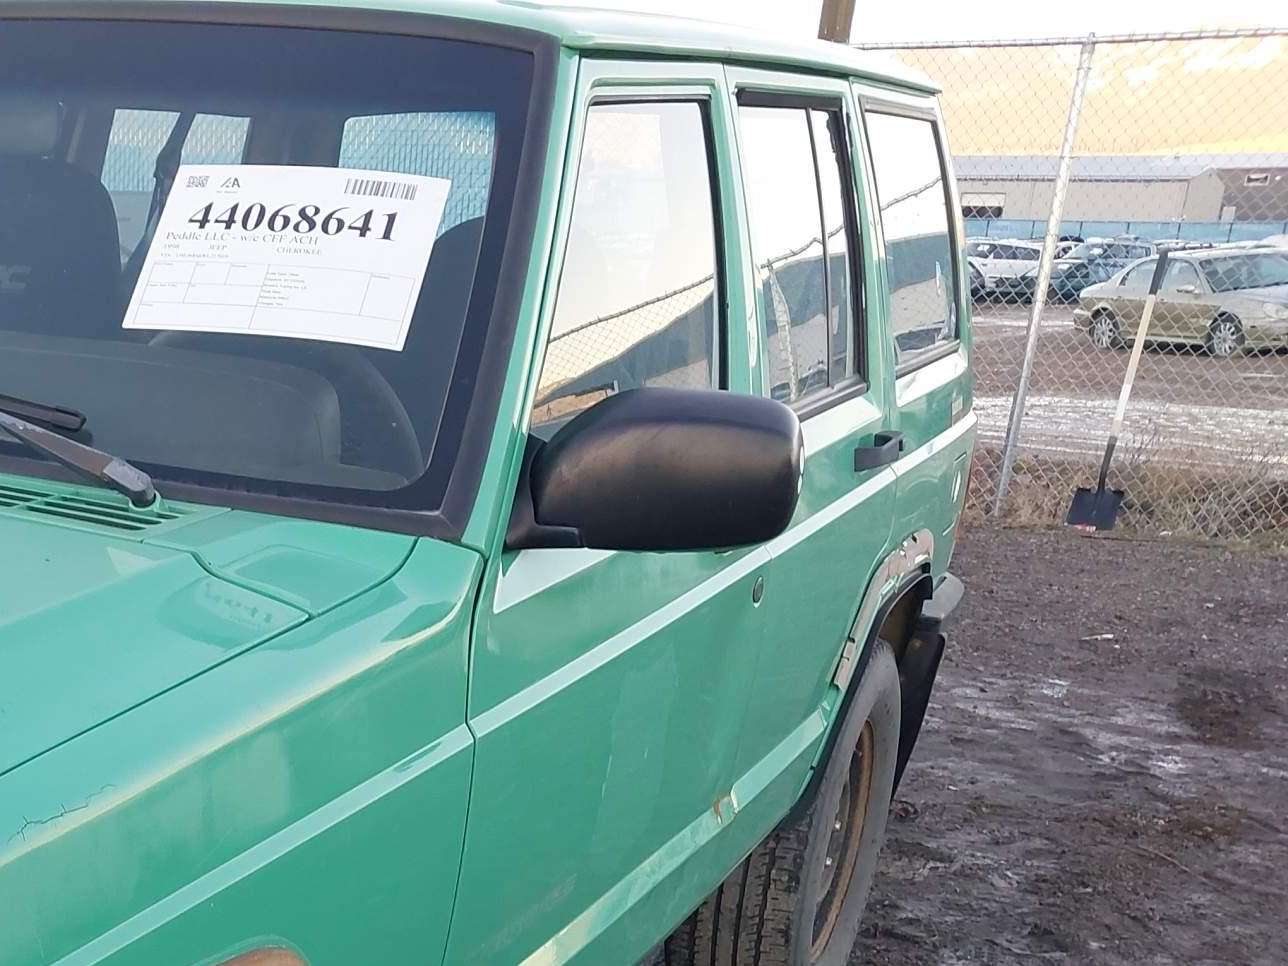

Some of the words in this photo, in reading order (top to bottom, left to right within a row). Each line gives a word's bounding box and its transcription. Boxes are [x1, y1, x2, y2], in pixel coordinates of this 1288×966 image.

[187, 201, 399, 242] 44068641
[165, 231, 202, 241] Peddle
[204, 231, 230, 242] LLC
[276, 245, 323, 257] CHEROKEE
